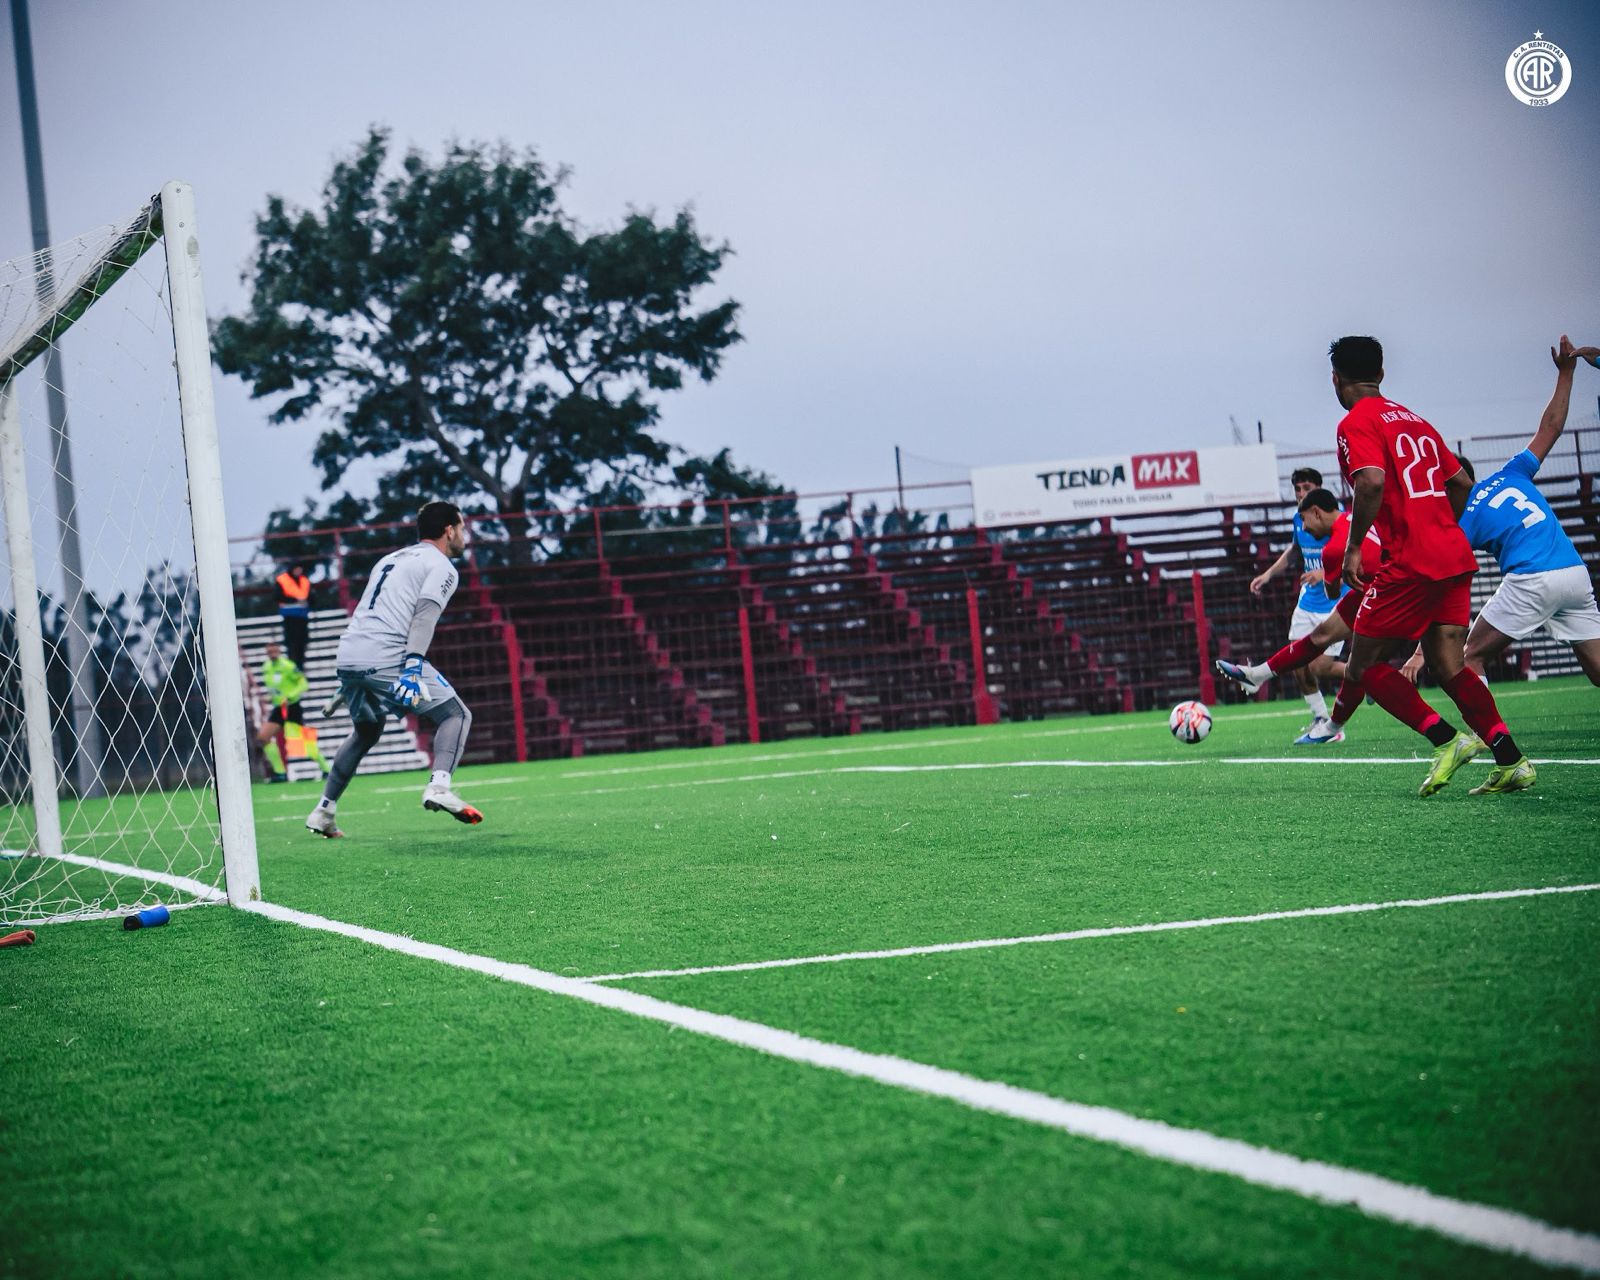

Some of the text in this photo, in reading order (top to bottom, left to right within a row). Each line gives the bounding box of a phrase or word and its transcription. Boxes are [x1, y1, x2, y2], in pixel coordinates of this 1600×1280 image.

[1036, 465, 1126, 490] TIENDA
[1395, 433, 1447, 499] 22
[1099, 496, 1124, 506] PARA
[1125, 495, 1137, 504] EL
[1138, 492, 1173, 503] HOGAR
[1488, 487, 1546, 529] 3
[368, 564, 395, 610] 1
